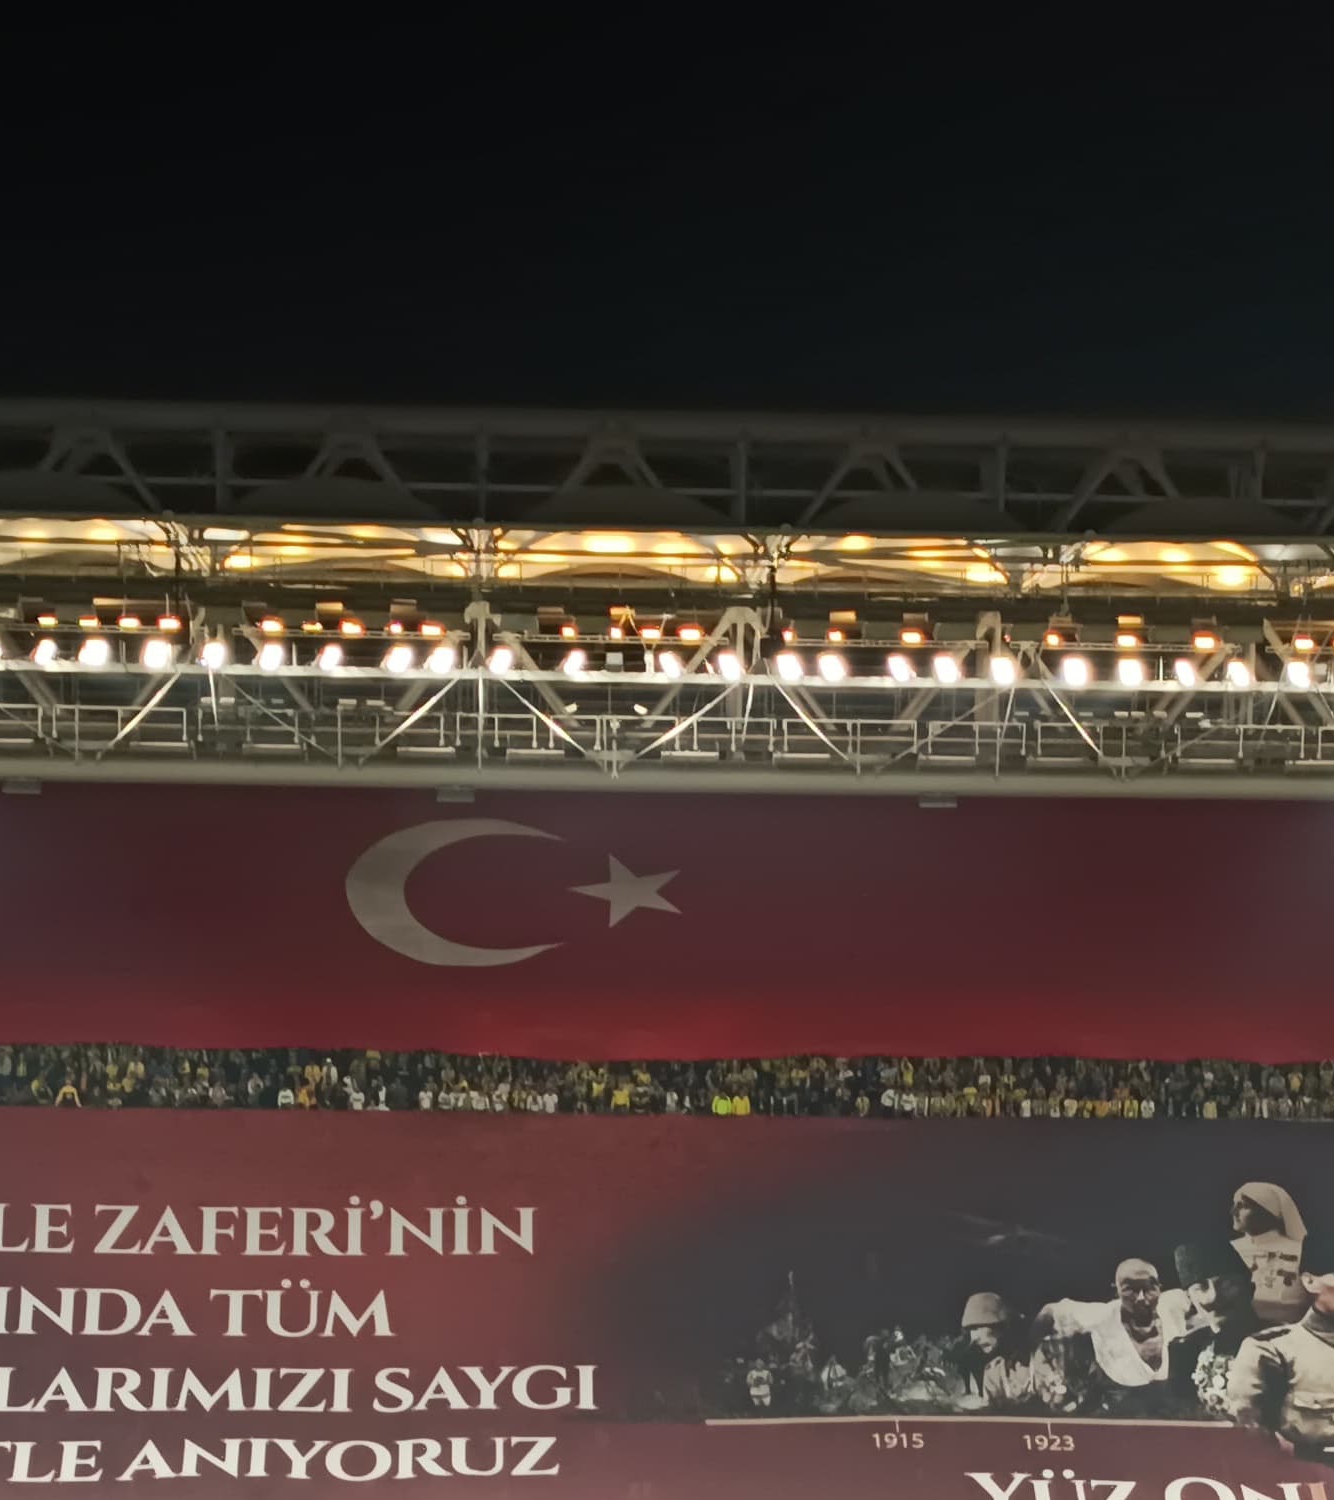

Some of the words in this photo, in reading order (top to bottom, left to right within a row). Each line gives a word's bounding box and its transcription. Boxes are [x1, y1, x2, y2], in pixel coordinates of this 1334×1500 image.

[210, 1279, 396, 1337] TÜM
[372, 1364, 598, 1412] SAYGI
[116, 1436, 560, 1482] ANIYORUZ
[872, 1432, 924, 1449] 1915
[1023, 1433, 1075, 1452] 1923
